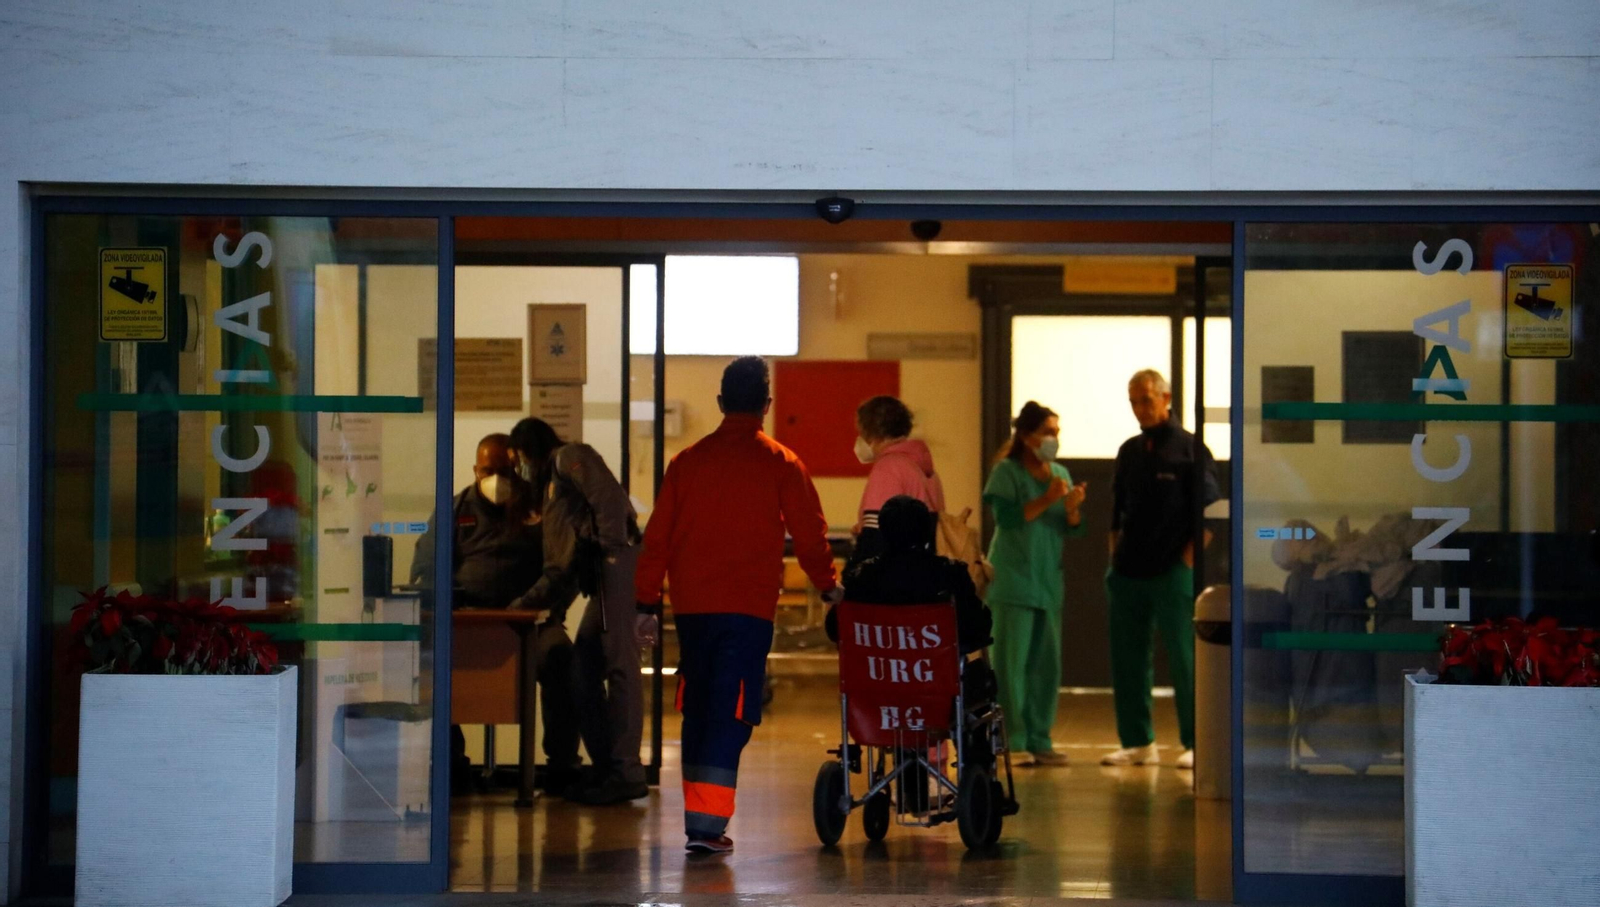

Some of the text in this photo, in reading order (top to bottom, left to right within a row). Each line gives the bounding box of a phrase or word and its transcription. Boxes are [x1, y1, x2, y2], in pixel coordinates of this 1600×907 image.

[103, 253, 163, 263] ZONA VIDEOVIGILADA
[1509, 269, 1570, 279] ZONA VIDEOVIGILADA
[853, 622, 941, 650] HURS
[866, 656, 934, 683] URG
